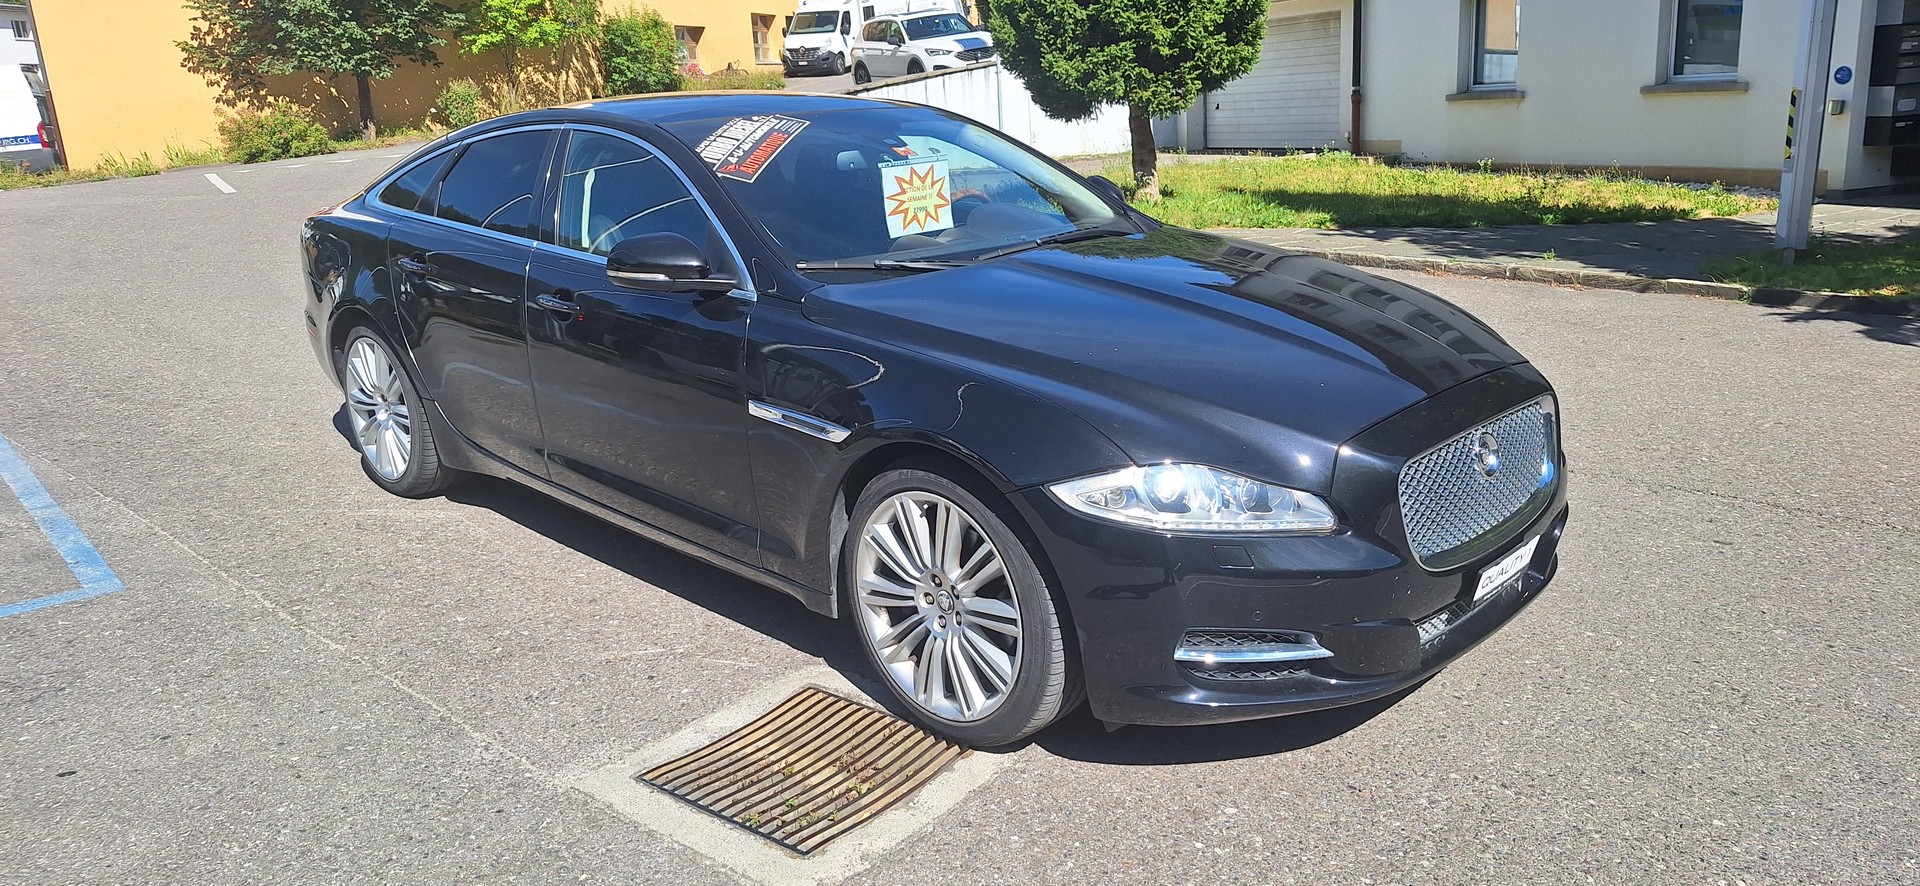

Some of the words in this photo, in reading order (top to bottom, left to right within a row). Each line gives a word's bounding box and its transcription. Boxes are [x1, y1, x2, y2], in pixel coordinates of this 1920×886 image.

[700, 136, 738, 164] TURBO
[740, 131, 788, 174] AUTOMATIQUE
[907, 195, 928, 203] SEMAINE
